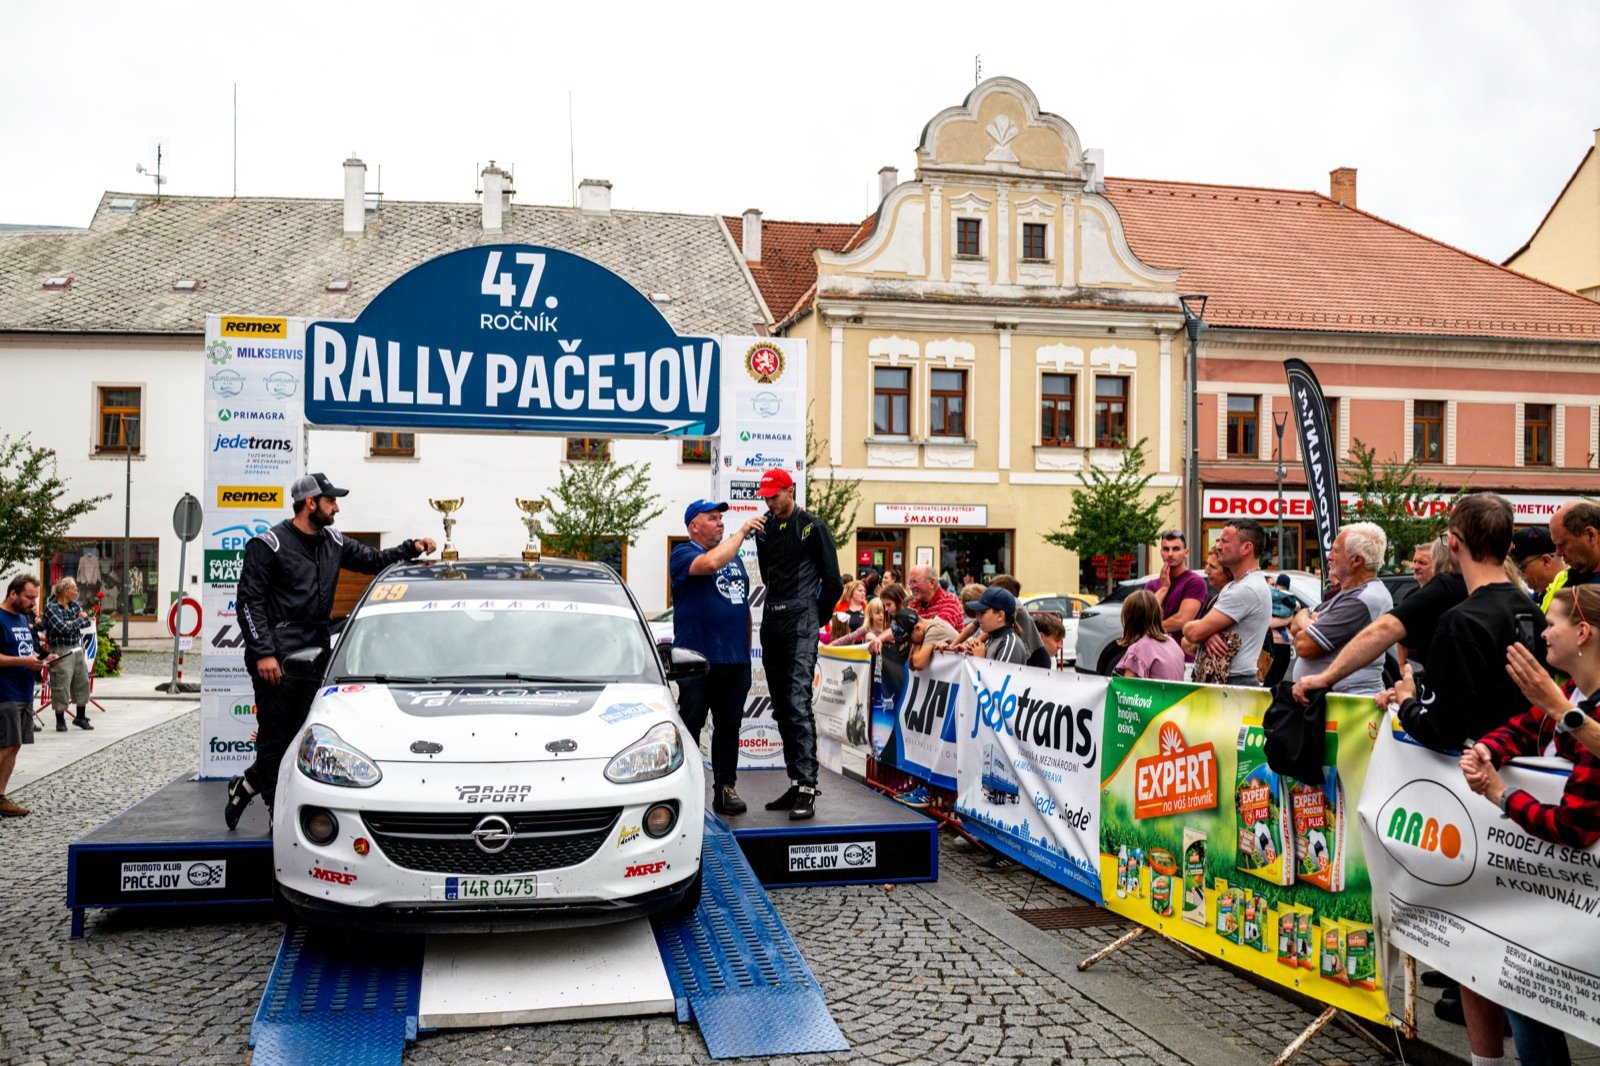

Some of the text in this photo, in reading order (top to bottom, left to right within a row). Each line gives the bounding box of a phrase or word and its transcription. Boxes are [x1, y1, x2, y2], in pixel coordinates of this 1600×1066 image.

[481, 250, 559, 310] 47.
[480, 311, 558, 333] ROČNÍK
[237, 347, 303, 360] MILKSERVIS
[313, 325, 714, 414] RALLY PAČEJOV
[233, 411, 284, 420] PRIMAGRA
[752, 433, 792, 441] PRIMAGRA
[904, 513, 959, 524] ŠMAKOUN
[370, 584, 409, 601] 69
[1116, 691, 1153, 708] Trávníková
[1117, 721, 1136, 736] osiva,
[738, 739, 768, 748] BOSCH
[1138, 750, 1213, 801] EXPERT
[467, 794, 529, 804] SPORT
[1163, 790, 1213, 812] na váš trávník
[1242, 788, 1269, 804] EXPERT
[1293, 791, 1323, 809] EXPERT
[1255, 808, 1268, 819] PLUS
[1308, 817, 1324, 828] PLUS
[1387, 806, 1462, 859] ARBO
[790, 845, 839, 854] AUTOMOTO KLUB
[1487, 826, 1544, 855] PRODEJ
[1544, 844, 1556, 860] A
[123, 863, 182, 873] AUTOMOTO KLUB
[624, 861, 666, 878] MRF
[790, 854, 838, 870] PAČEJOV
[1487, 851, 1599, 891] ZEMĚDĚLSKÉ,
[122, 871, 181, 889] PAČEJOV
[313, 867, 357, 886] MRF
[461, 878, 534, 896] 14R 0475
[1496, 876, 1600, 914] A KOMUNÁLNÍ
[1505, 945, 1600, 990] SERVIS A SKLAD NÁHRAD
[1504, 956, 1534, 979] Rozvojová
[1535, 972, 1555, 985] zóna
[1575, 985, 1590, 998] 340
[1513, 975, 1531, 988] +420
[1532, 980, 1547, 993] 376
[1547, 986, 1563, 999] 375
[1564, 994, 1578, 1005] 411
[1498, 978, 1537, 1000] NON-STOP
[1538, 994, 1589, 1021] OPERÁTOR:
